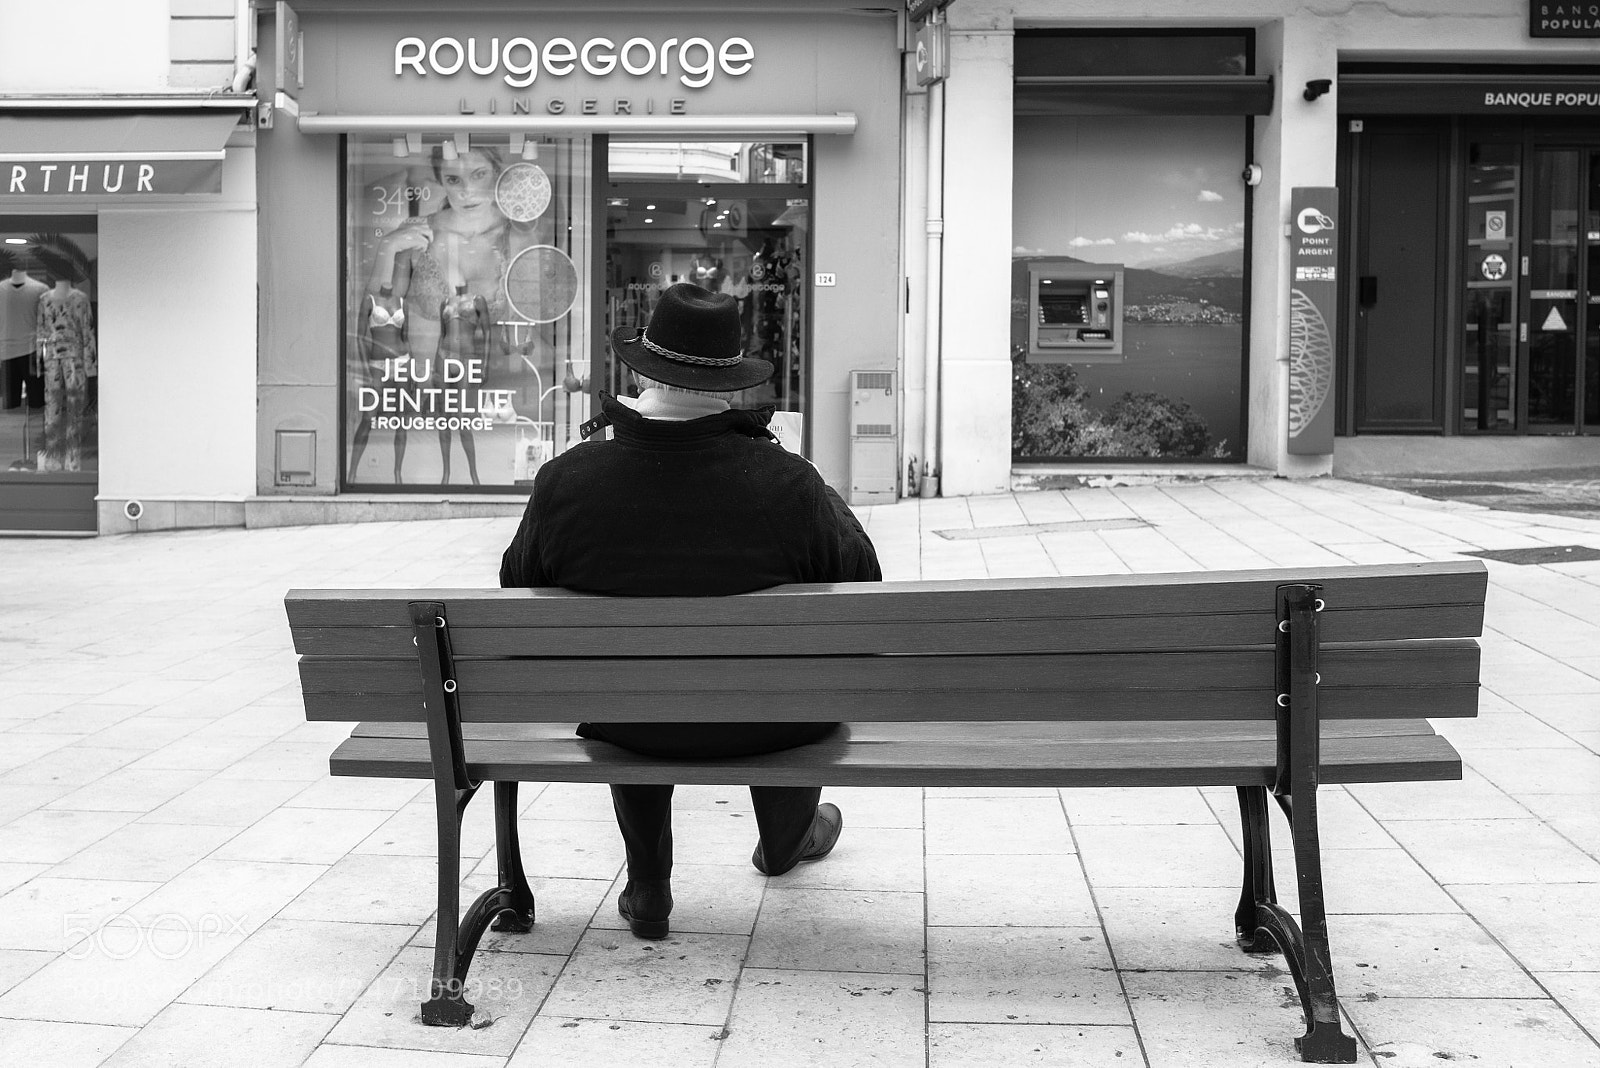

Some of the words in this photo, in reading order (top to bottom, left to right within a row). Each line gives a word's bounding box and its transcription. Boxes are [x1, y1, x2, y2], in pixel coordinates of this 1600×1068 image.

[459, 97, 688, 115] LINGERIE
[1484, 92, 1553, 108] BANQUE
[1555, 92, 1600, 106] POPU
[1302, 236, 1330, 245] POINT
[1298, 247, 1333, 256] ARGENT
[818, 275, 833, 284] 124
[381, 357, 431, 383] JEU
[443, 358, 483, 384] DE
[358, 387, 509, 414] DENTELLE
[377, 416, 494, 431] ROUGEGORGE
